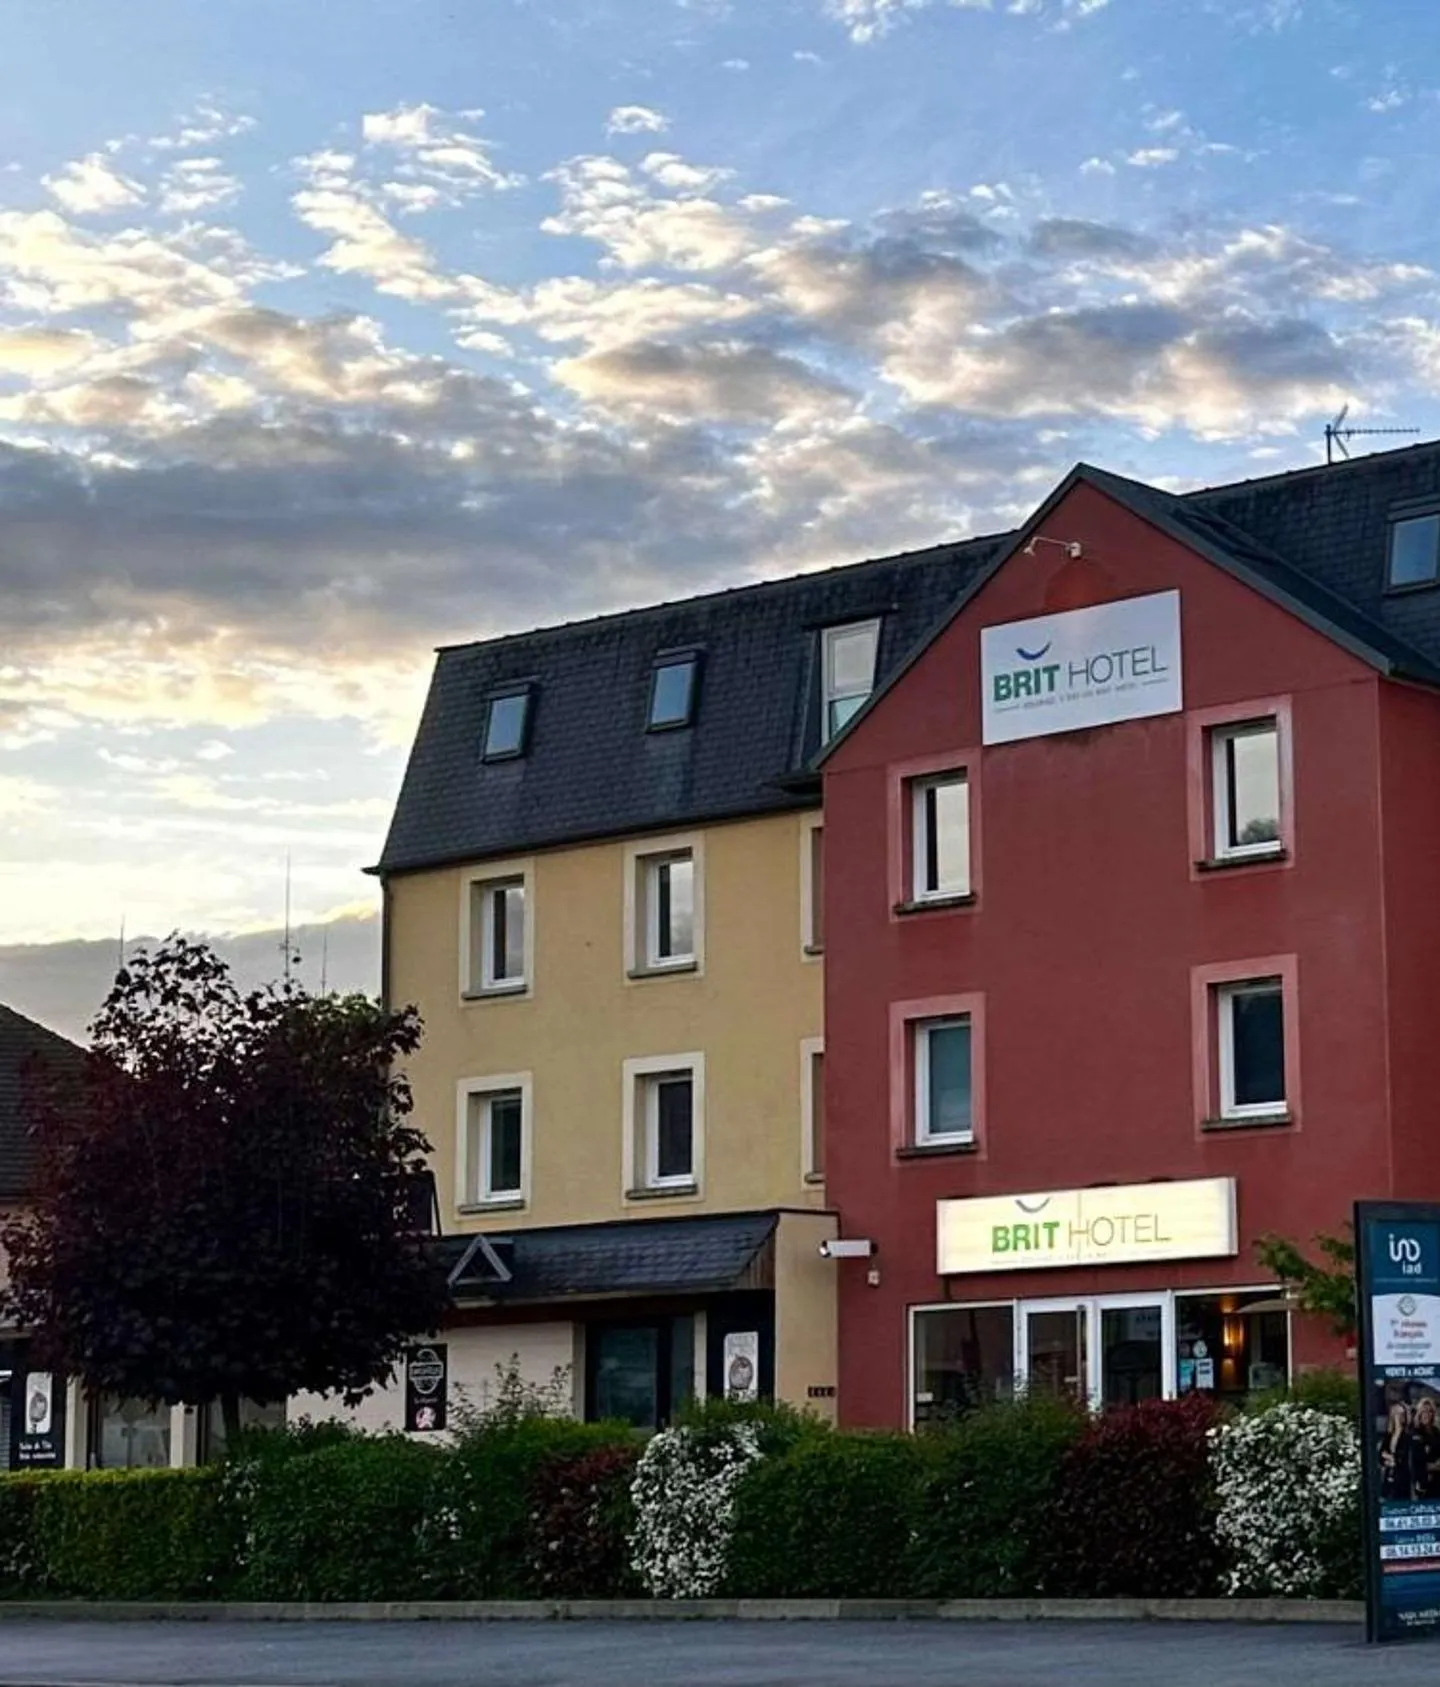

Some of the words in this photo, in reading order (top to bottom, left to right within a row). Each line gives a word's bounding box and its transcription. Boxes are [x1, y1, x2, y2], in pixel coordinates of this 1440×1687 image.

[993, 664, 1061, 702] BRIT
[1068, 646, 1168, 687] HOTEL
[992, 1221, 1060, 1253] BRIT
[1068, 1214, 1172, 1248] HOTEL
[1402, 1262, 1422, 1275] iad
